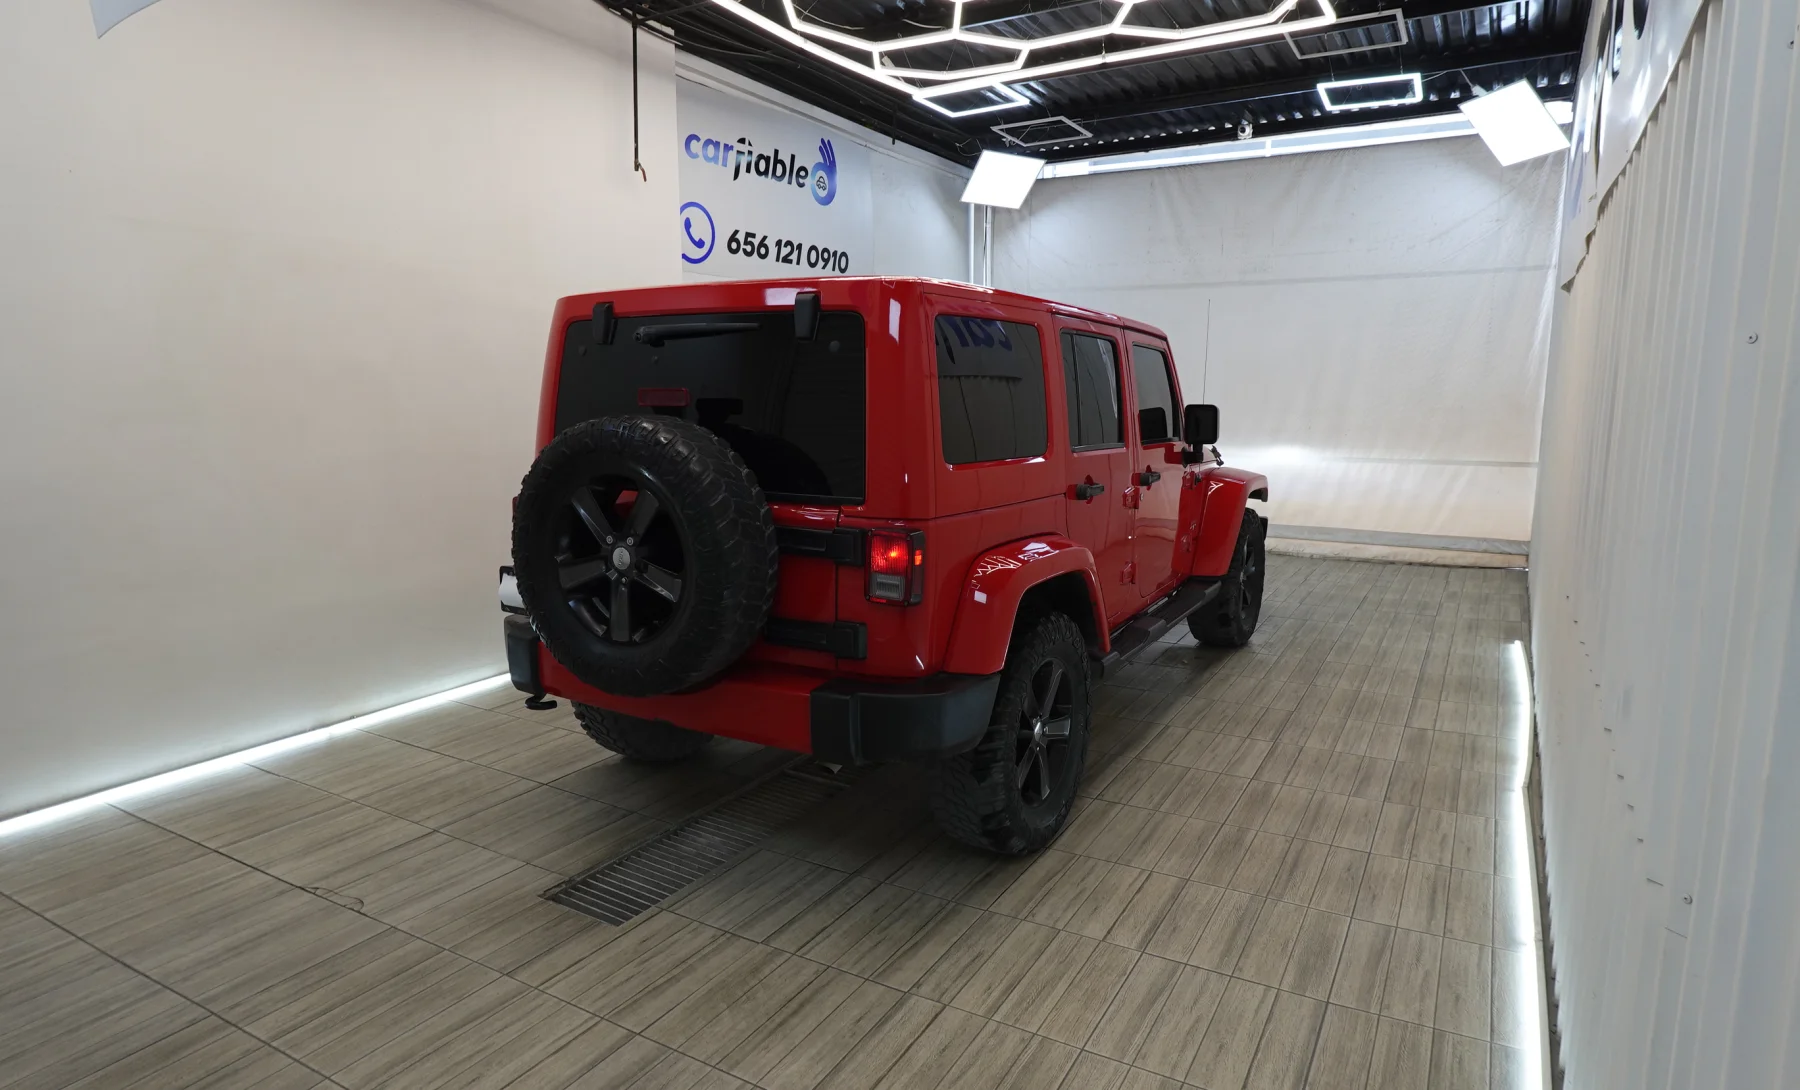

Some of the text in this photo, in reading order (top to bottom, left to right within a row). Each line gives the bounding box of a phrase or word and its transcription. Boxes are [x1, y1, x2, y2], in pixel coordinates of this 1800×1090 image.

[684, 133, 809, 188] carfiable
[727, 229, 849, 274] 656 121 0910
